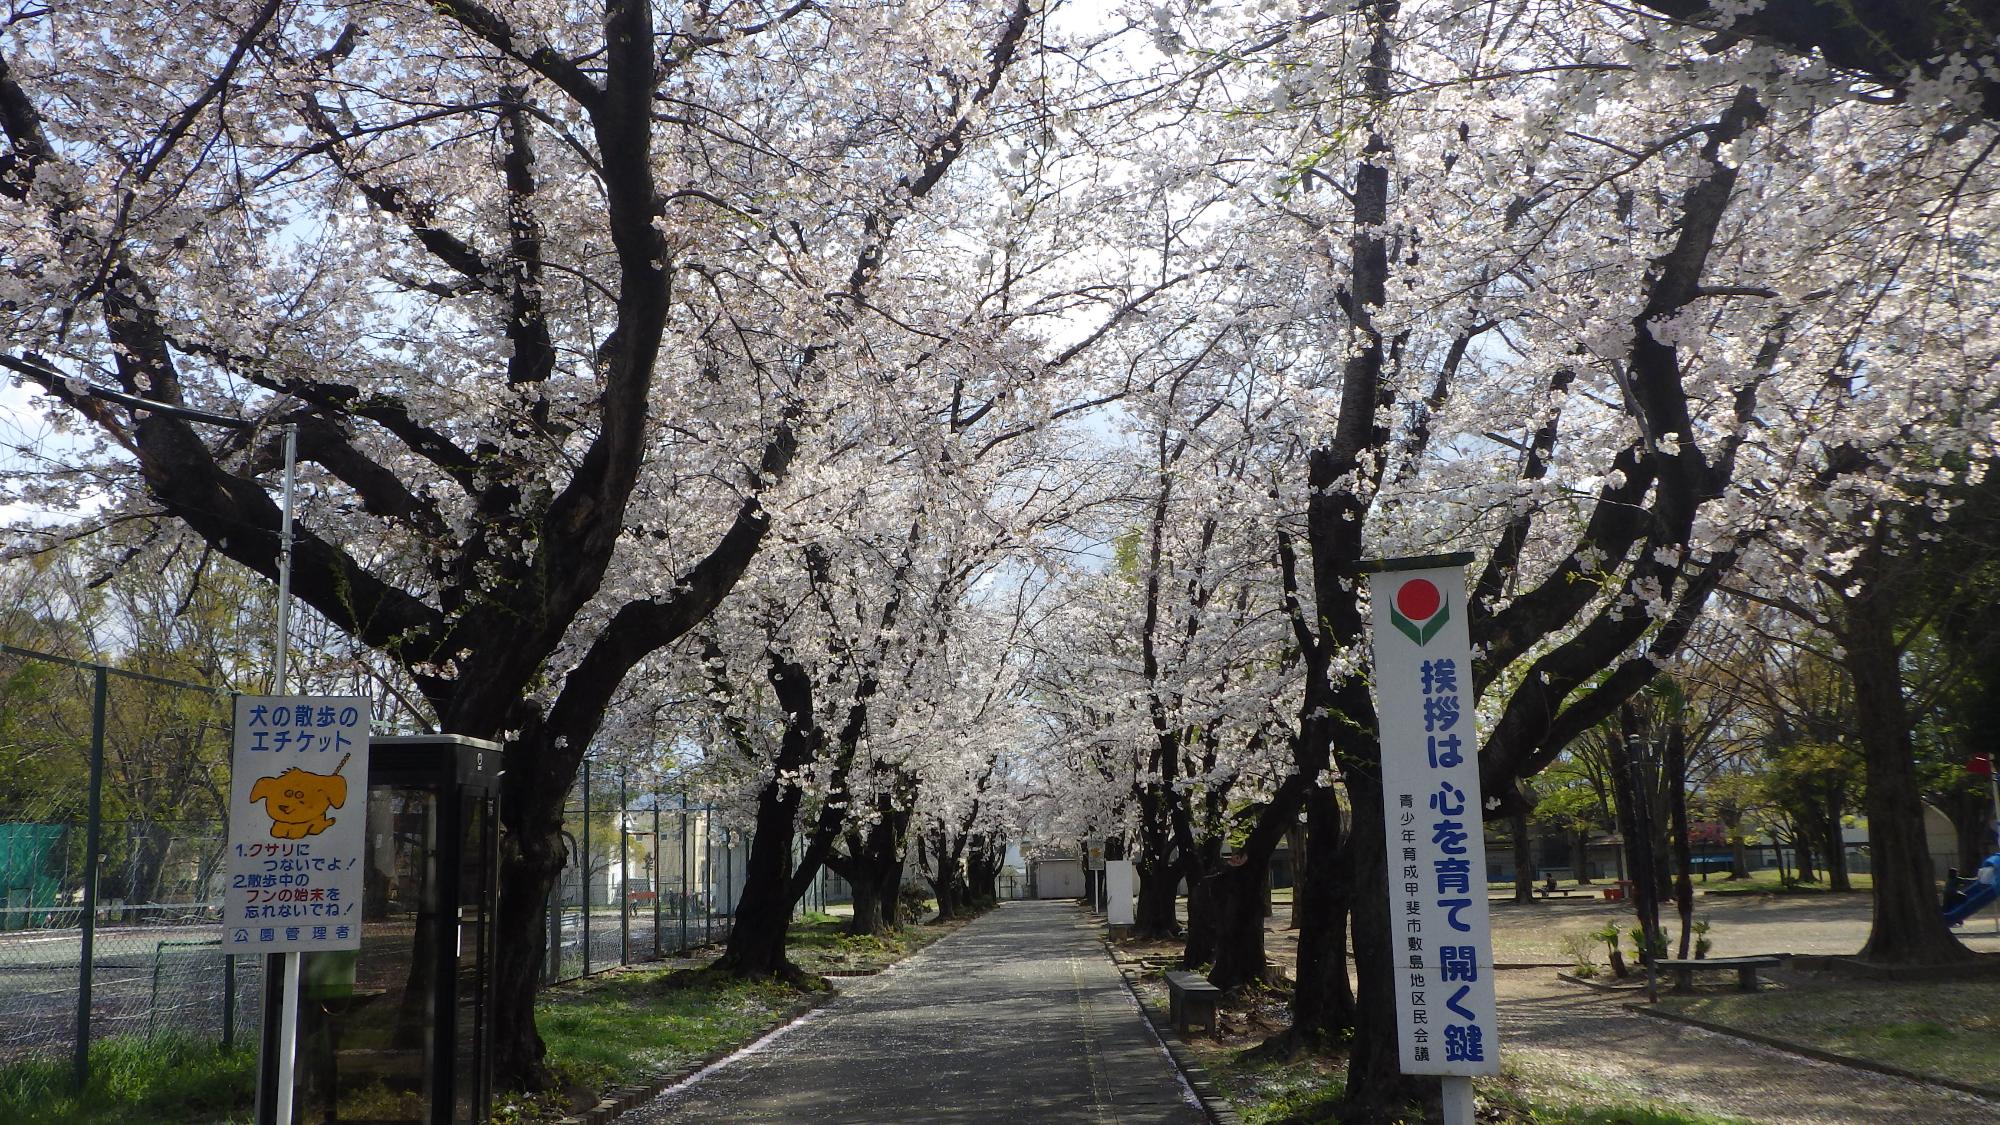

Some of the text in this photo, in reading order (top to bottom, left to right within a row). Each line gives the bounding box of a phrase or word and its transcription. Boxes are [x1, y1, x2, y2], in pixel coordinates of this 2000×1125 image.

[249, 705, 358, 728] 犬の散歩の
[251, 730, 352, 752] エチケット
[246, 888, 340, 903] フンの始末を
[234, 925, 350, 942] 公園管理者
[1399, 794, 1430, 1062] 青少年育成甲斐市敷島地区民会議
